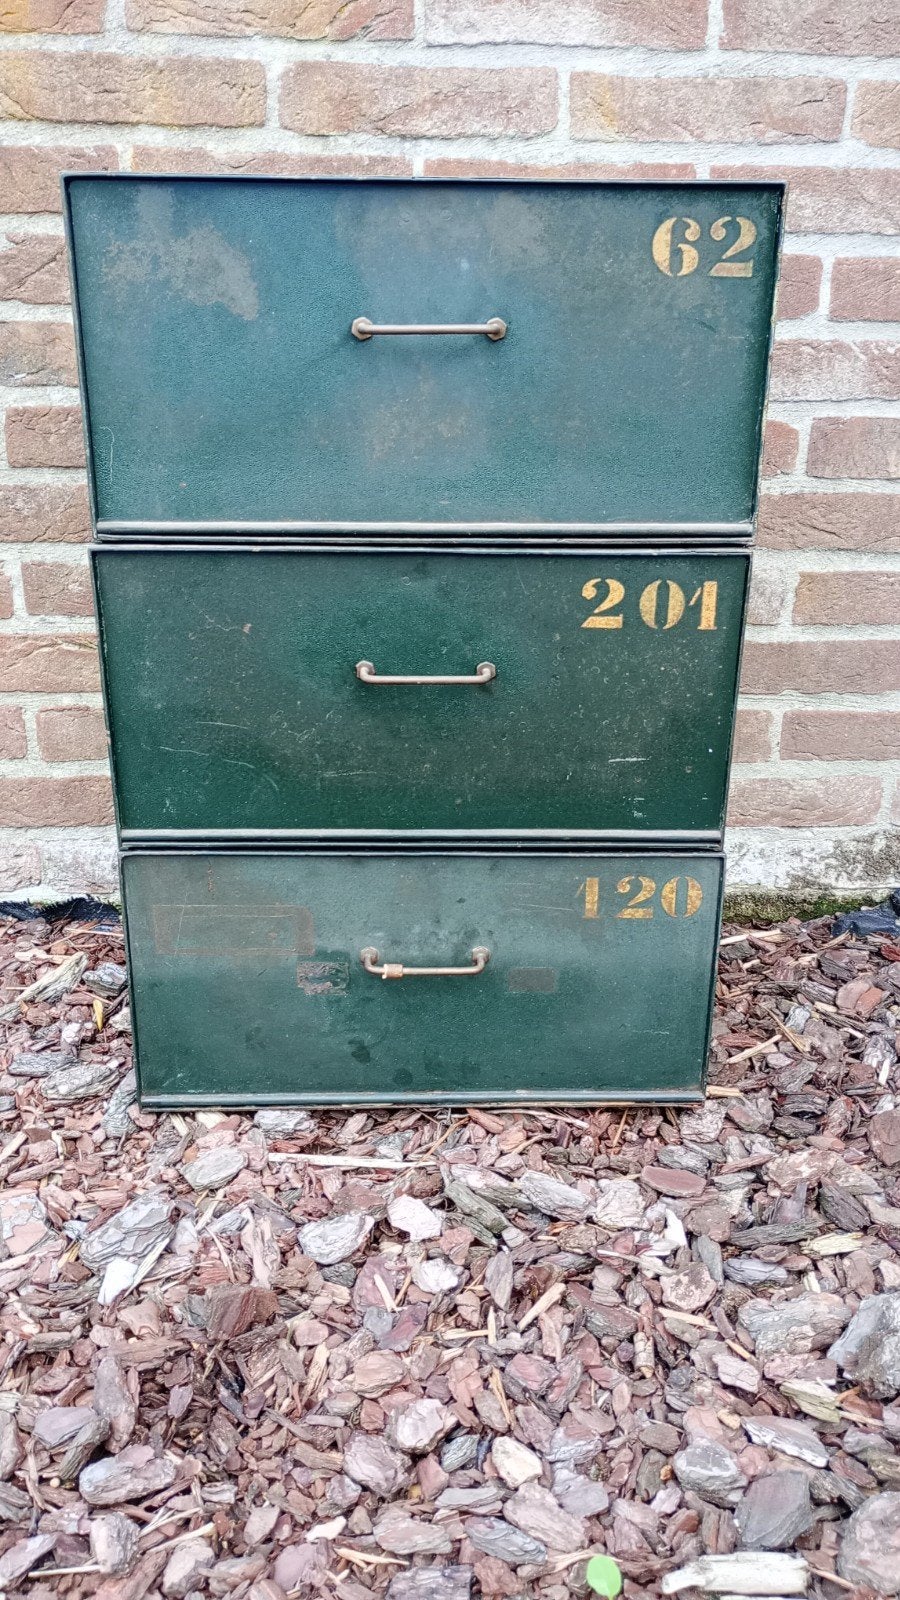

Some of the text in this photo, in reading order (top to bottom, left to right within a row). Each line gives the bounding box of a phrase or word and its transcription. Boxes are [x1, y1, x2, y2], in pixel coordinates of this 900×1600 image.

[652, 216, 757, 278] 62
[581, 578, 718, 631] 201
[575, 876, 703, 919] 120
